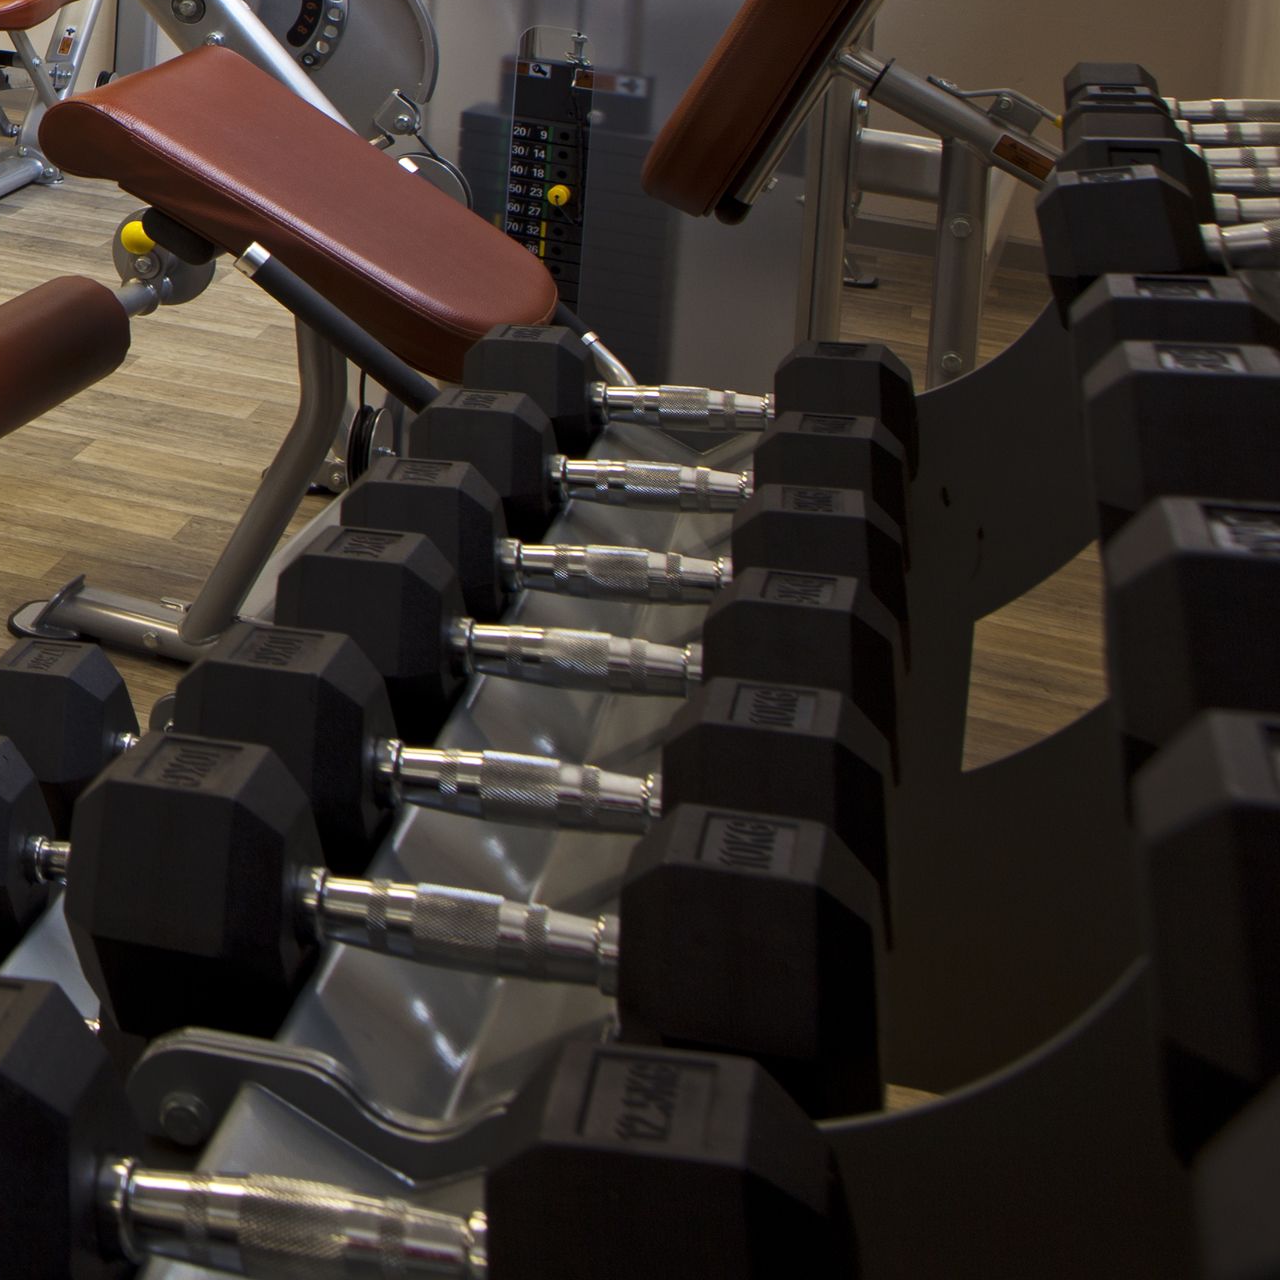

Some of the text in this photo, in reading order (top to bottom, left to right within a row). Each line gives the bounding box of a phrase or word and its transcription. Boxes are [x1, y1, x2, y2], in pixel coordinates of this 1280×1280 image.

[540, 130, 548, 140] 9
[533, 149, 546, 159] 14
[531, 168, 545, 179] 18
[529, 187, 543, 198] 23
[527, 206, 541, 217] 27
[526, 225, 540, 236] 32
[748, 689, 799, 728] 10KG
[159, 747, 221, 789] 10KG
[717, 820, 779, 871] 10KG
